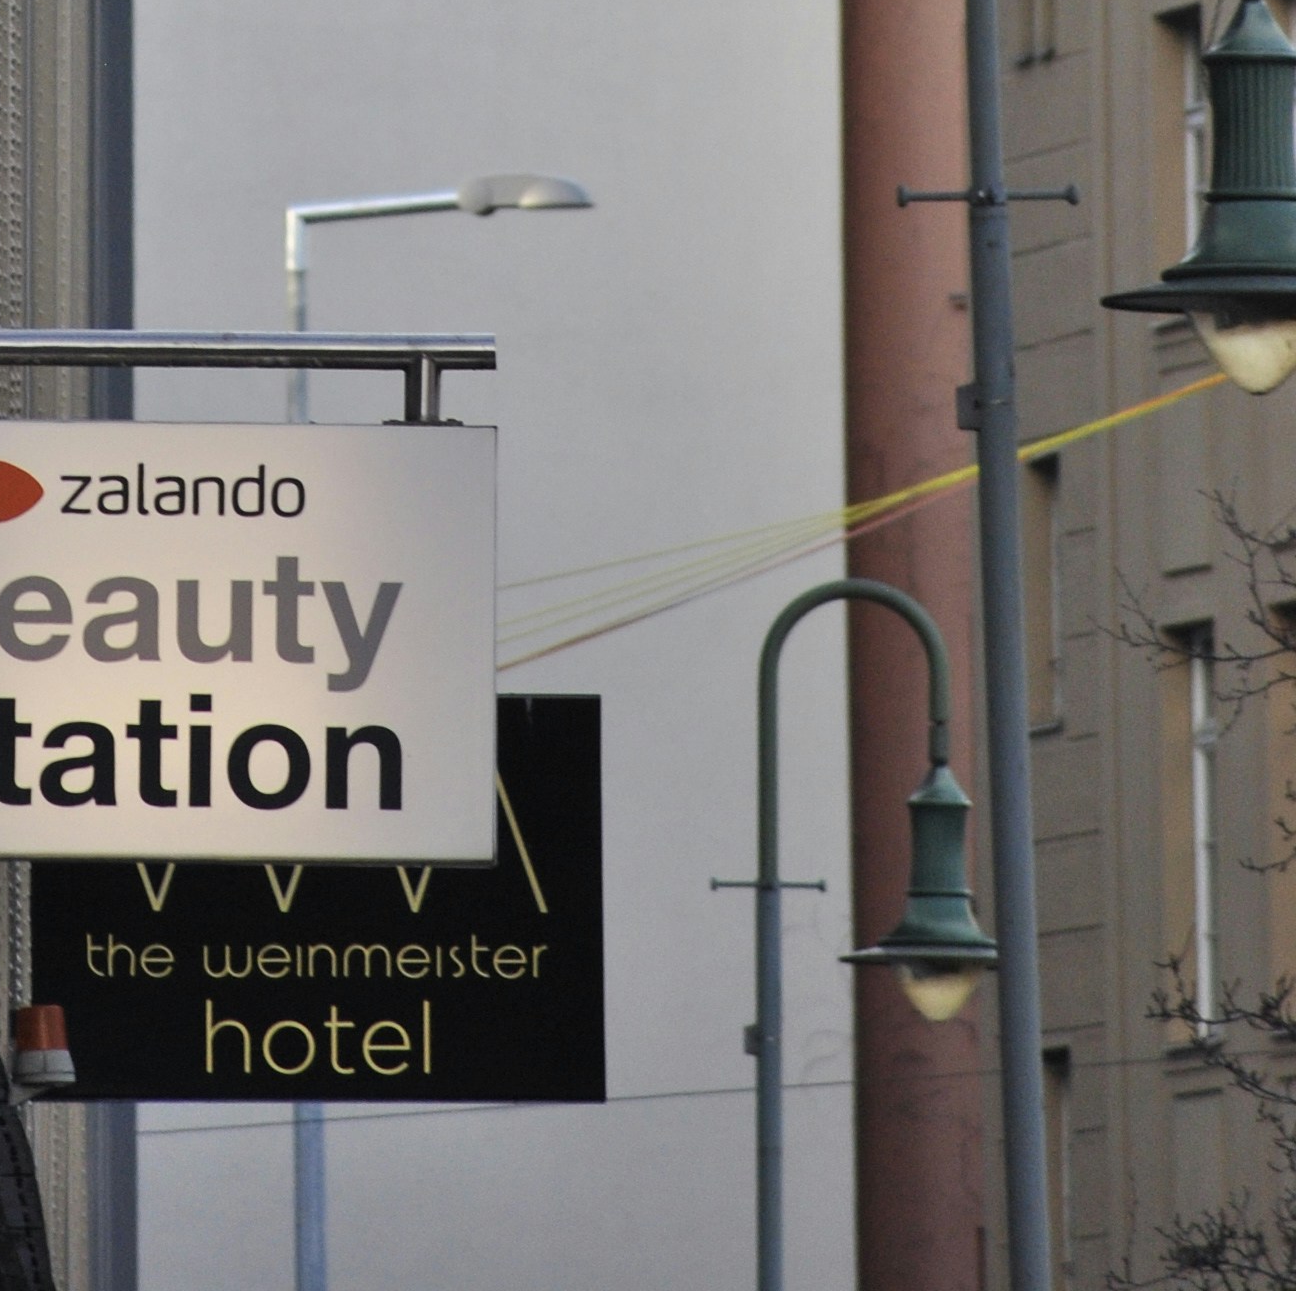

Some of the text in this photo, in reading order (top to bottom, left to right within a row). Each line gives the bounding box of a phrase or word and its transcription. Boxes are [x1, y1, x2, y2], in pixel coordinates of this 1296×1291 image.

[60, 463, 306, 518] zalando
[86, 933, 548, 980] the weinmeister
[205, 999, 432, 1075] hotel
